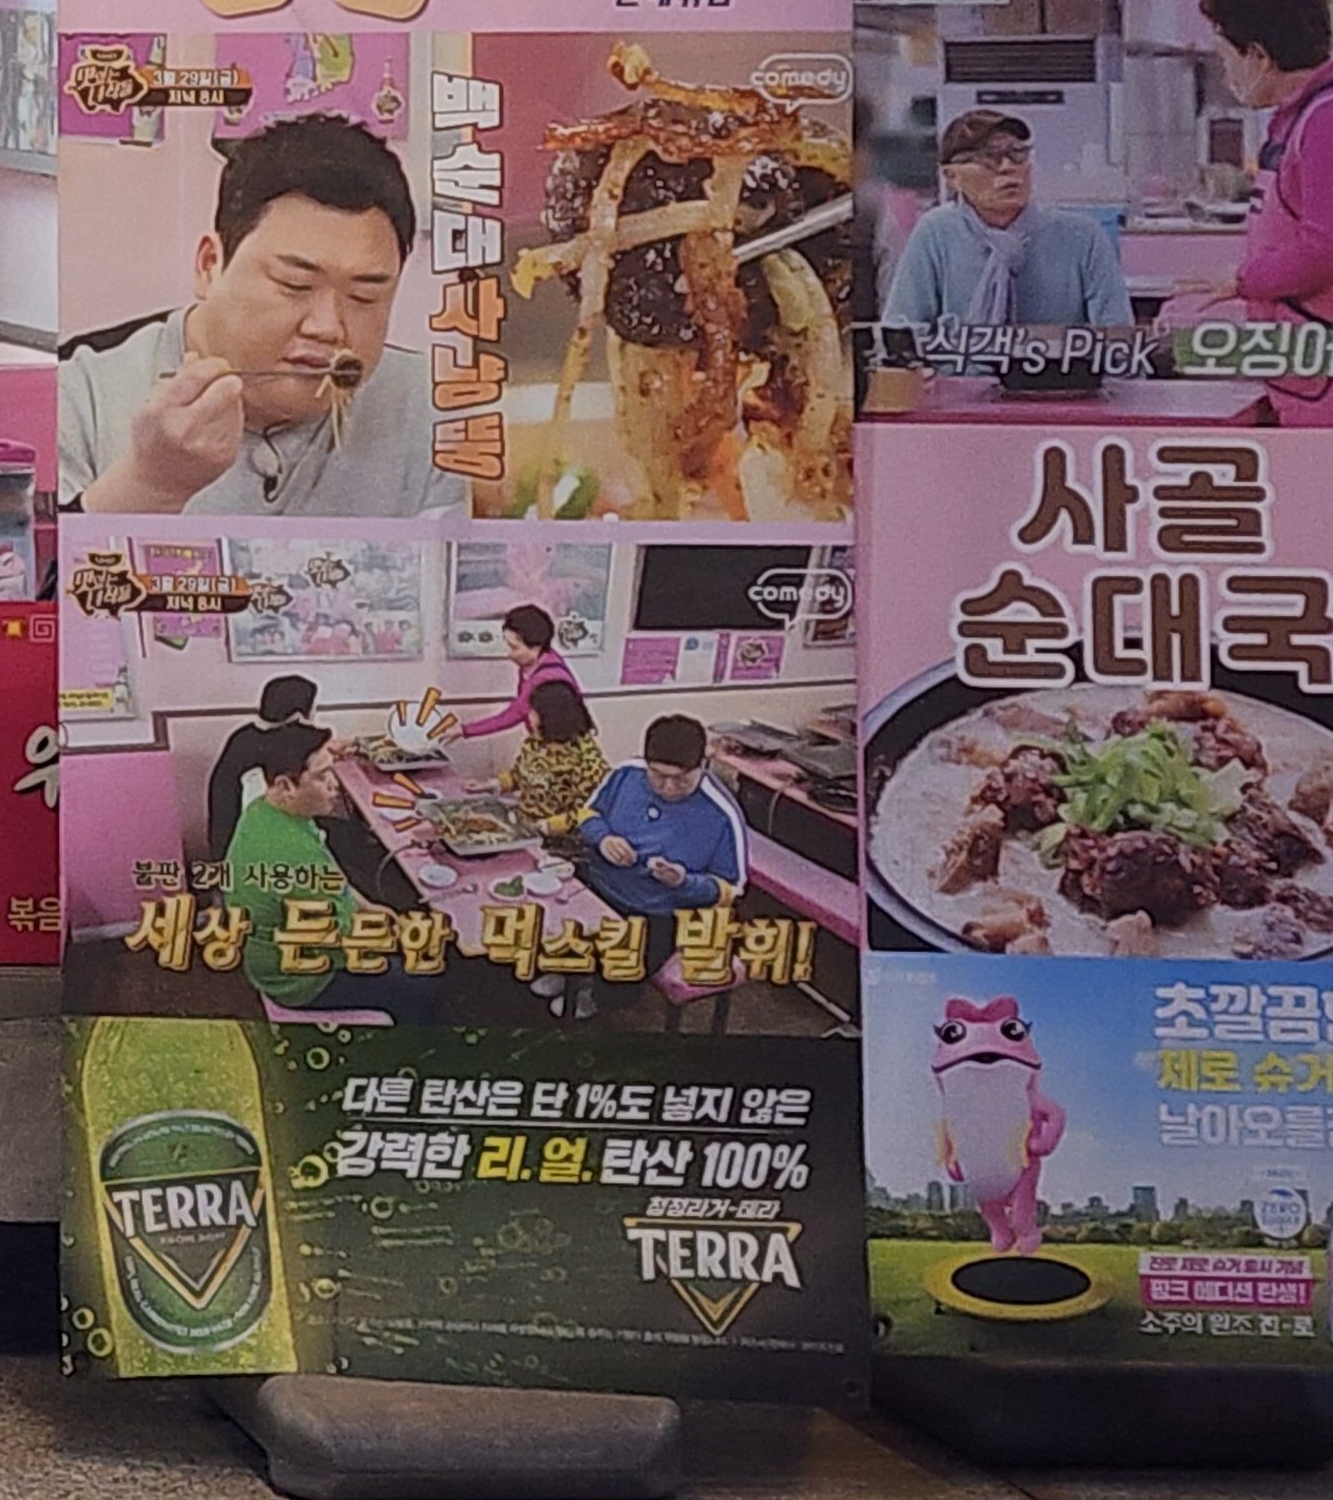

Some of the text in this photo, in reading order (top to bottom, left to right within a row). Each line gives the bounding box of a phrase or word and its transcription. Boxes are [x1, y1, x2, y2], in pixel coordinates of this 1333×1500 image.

[750, 68, 847, 93] comedy
[1060, 328, 1160, 376] Pick
[1017, 442, 1269, 555] 사골
[747, 578, 848, 610] comedy
[956, 569, 1333, 685] 순대국
[191, 861, 233, 890] 2개
[244, 863, 346, 892] 사용하는
[125, 894, 253, 971] 세상
[273, 898, 455, 975] 든든한
[481, 902, 648, 981] 먹스킬
[1154, 981, 1333, 1046] 초깔끔
[1158, 1049, 1242, 1092] 제로
[341, 1077, 812, 1127] 다른 탄산은 단 1%도 넣지 않은
[1159, 1102, 1333, 1150] 날아오를
[336, 1129, 471, 1181] 강력한
[476, 1134, 531, 1182] 리.
[600, 1137, 693, 1187] 탄산
[700, 1139, 811, 1190] 100%
[111, 1179, 258, 1238] TERRA
[626, 1227, 803, 1288] TERRA
[1139, 1311, 1204, 1334] 소주의
[1207, 1312, 1255, 1336] 원조
